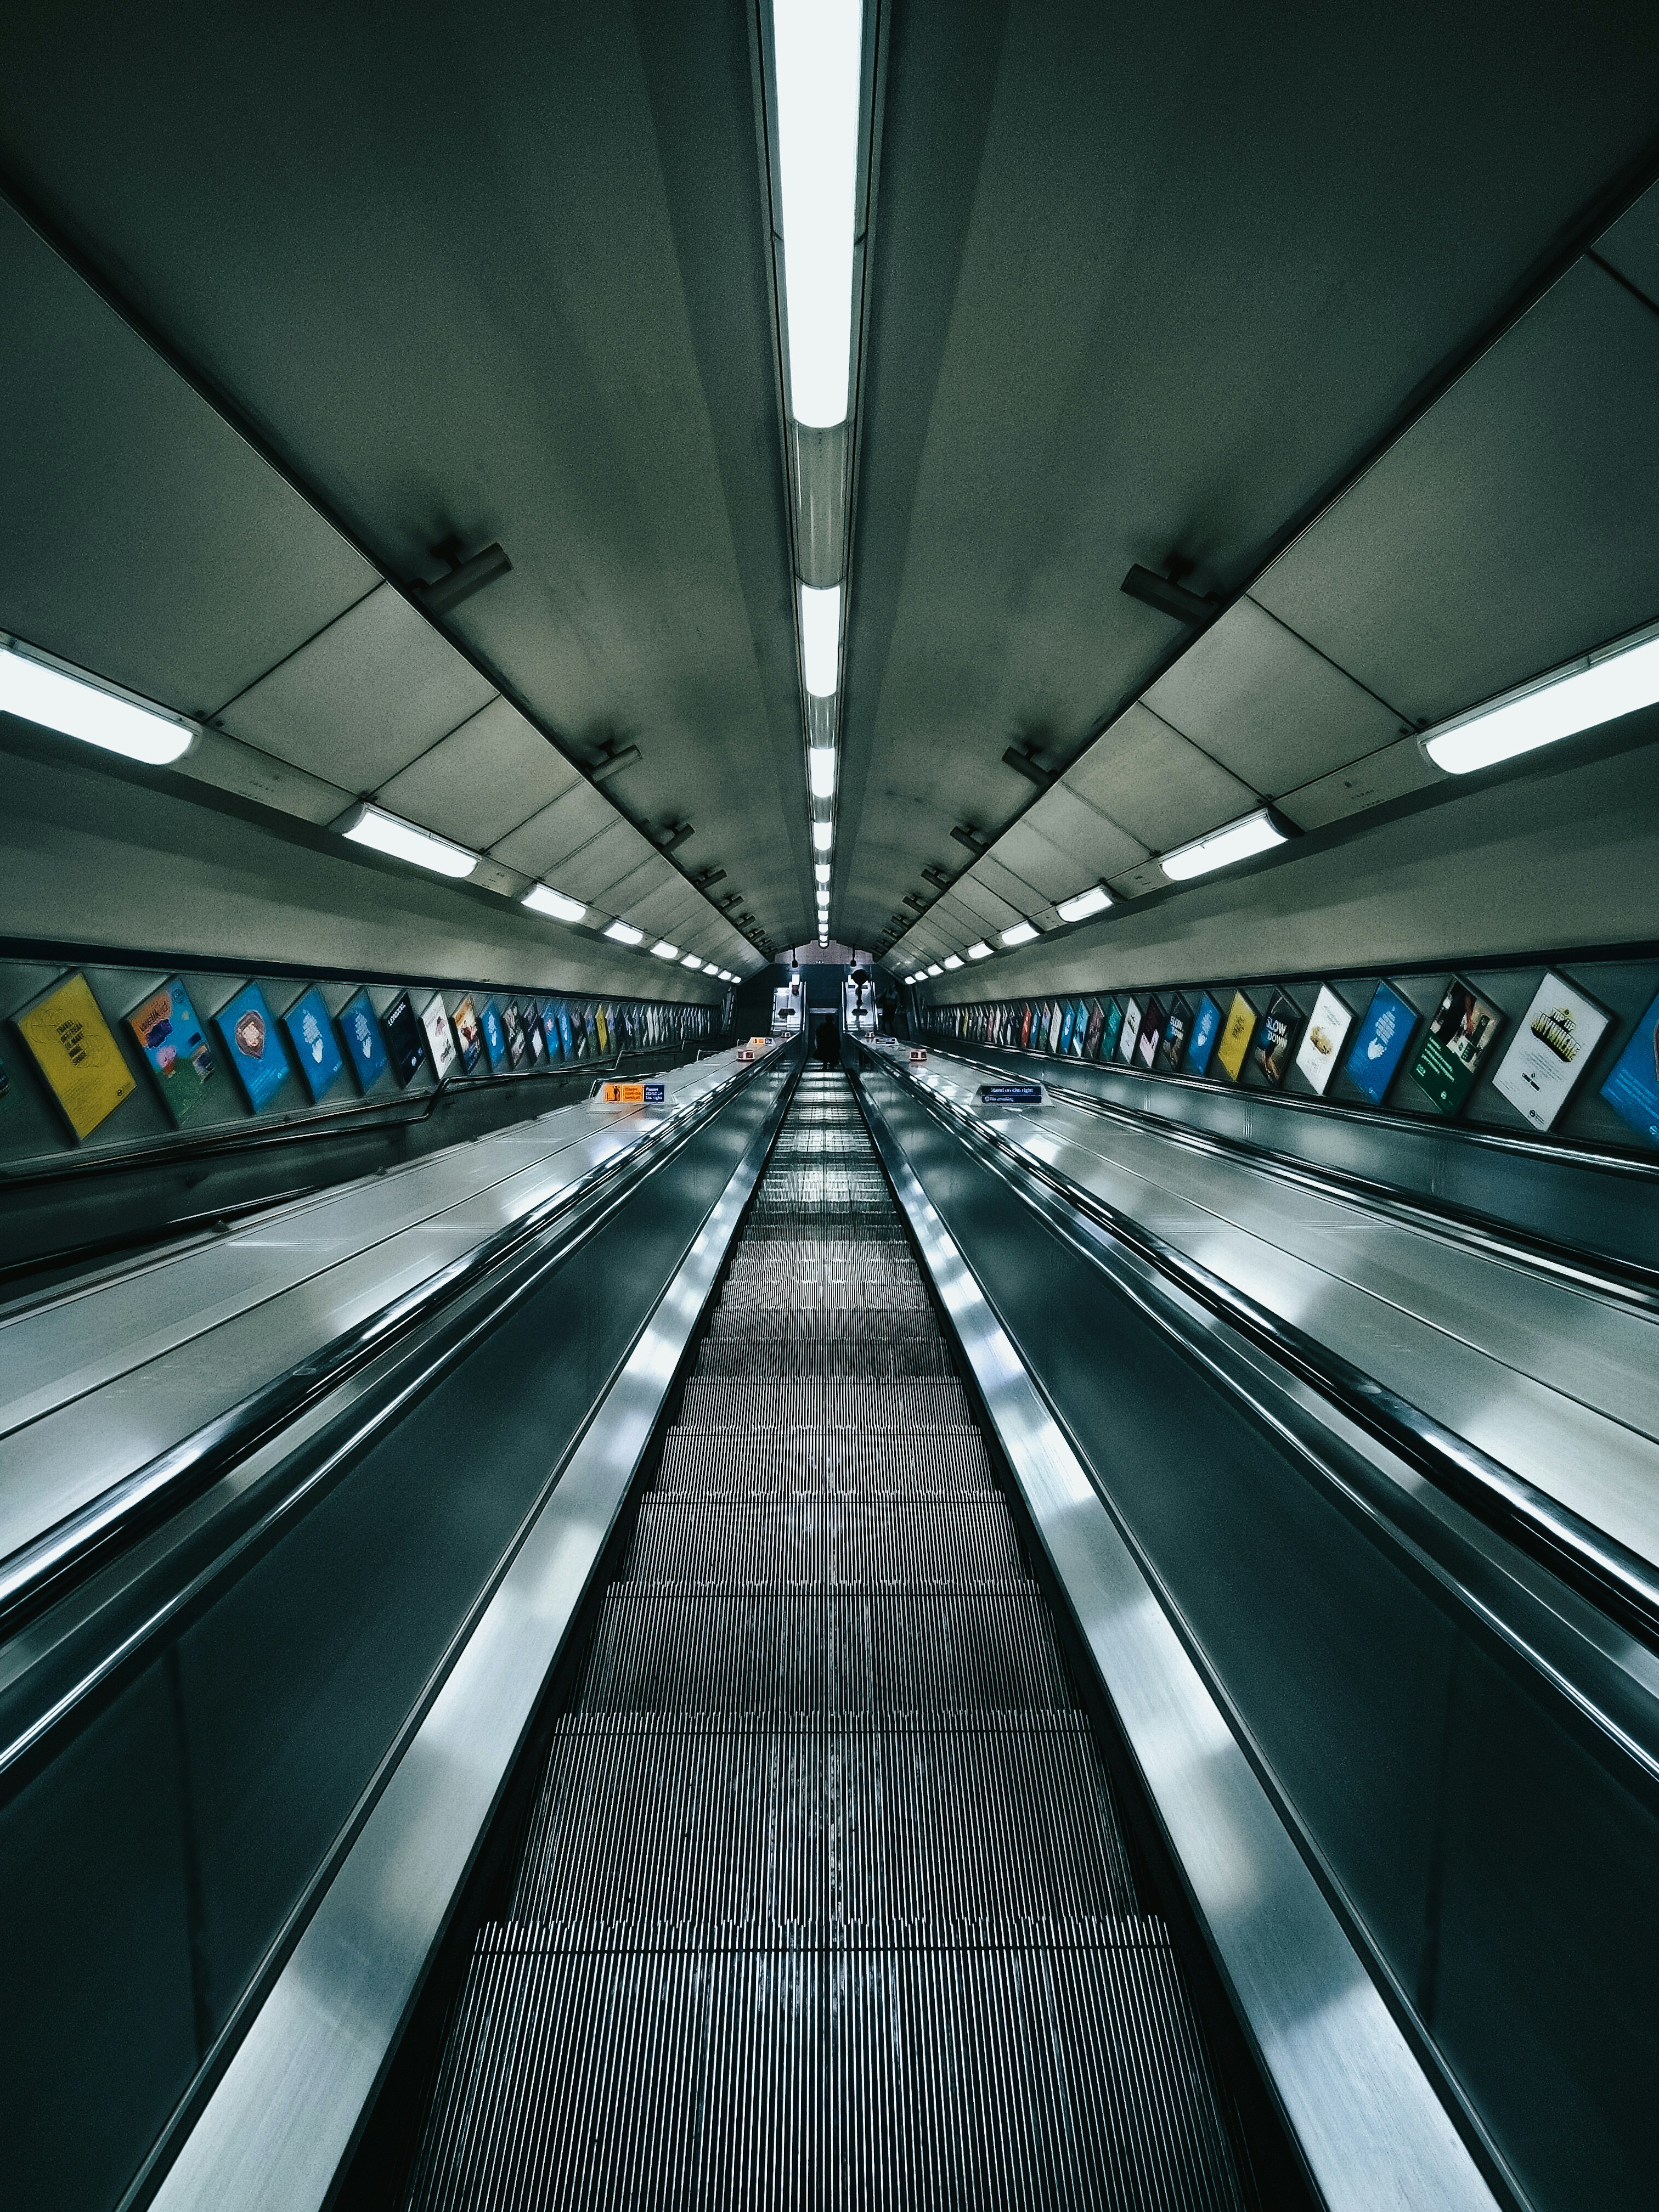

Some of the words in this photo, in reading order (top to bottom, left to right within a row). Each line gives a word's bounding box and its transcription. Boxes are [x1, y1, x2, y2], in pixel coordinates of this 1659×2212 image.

[1266, 1016, 1287, 1036] SLOW
[1551, 1006, 1565, 1022] TOP
[1564, 1018, 1576, 1031] UP
[1267, 1030, 1288, 1049] DOWN
[1531, 1012, 1582, 1063] ANYWHERE
